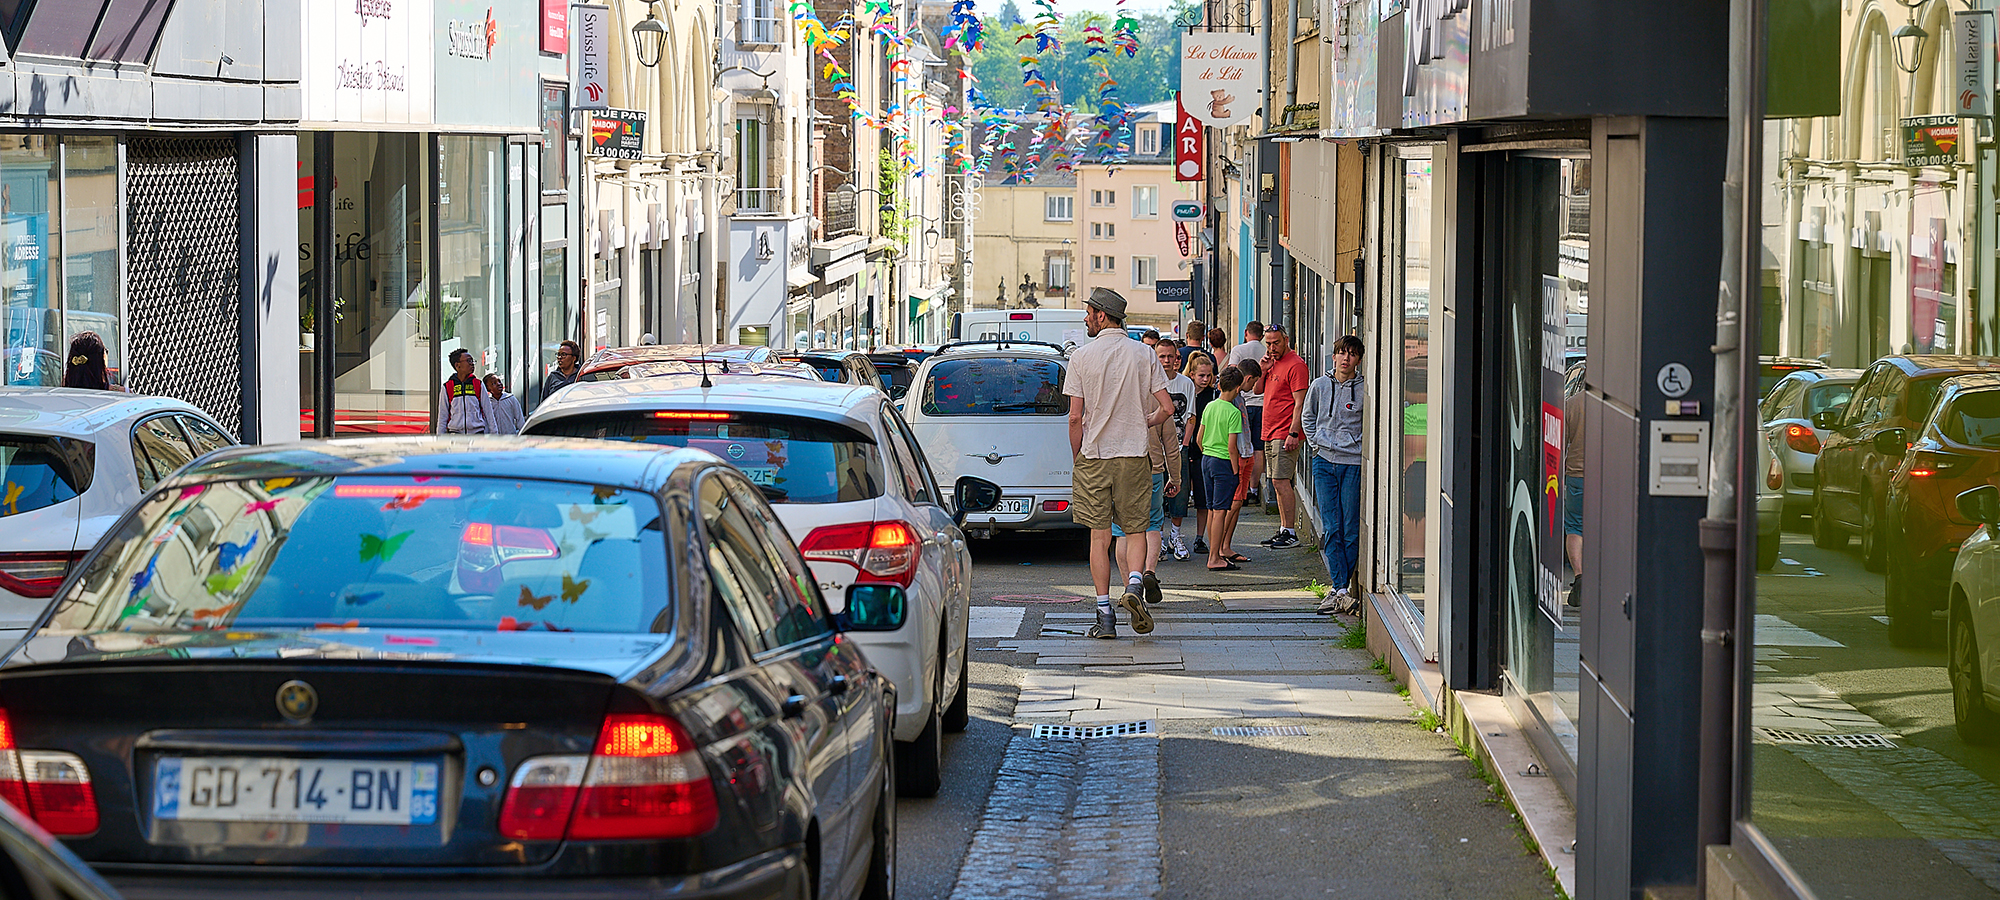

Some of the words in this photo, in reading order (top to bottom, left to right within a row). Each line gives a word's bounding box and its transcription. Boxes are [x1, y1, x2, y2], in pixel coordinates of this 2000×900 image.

[448, 19, 487, 60] SwissLife
[584, 13, 599, 80] SwissLife
[1184, 44, 1206, 60] La
[1209, 44, 1258, 60] Maison
[1198, 67, 1214, 80] de
[1216, 65, 1244, 80] Lili
[620, 111, 646, 121] PAR
[592, 120, 617, 129] AMBON
[1181, 117, 1198, 154] AR
[606, 147, 618, 158] 00
[619, 148, 630, 159] 06
[631, 150, 642, 160] 27
[1177, 221, 1188, 255] TABAC
[14, 245, 40, 260] ADRESSE
[189, 765, 402, 811] GD-714-BN
[411, 793, 436, 817] 85
